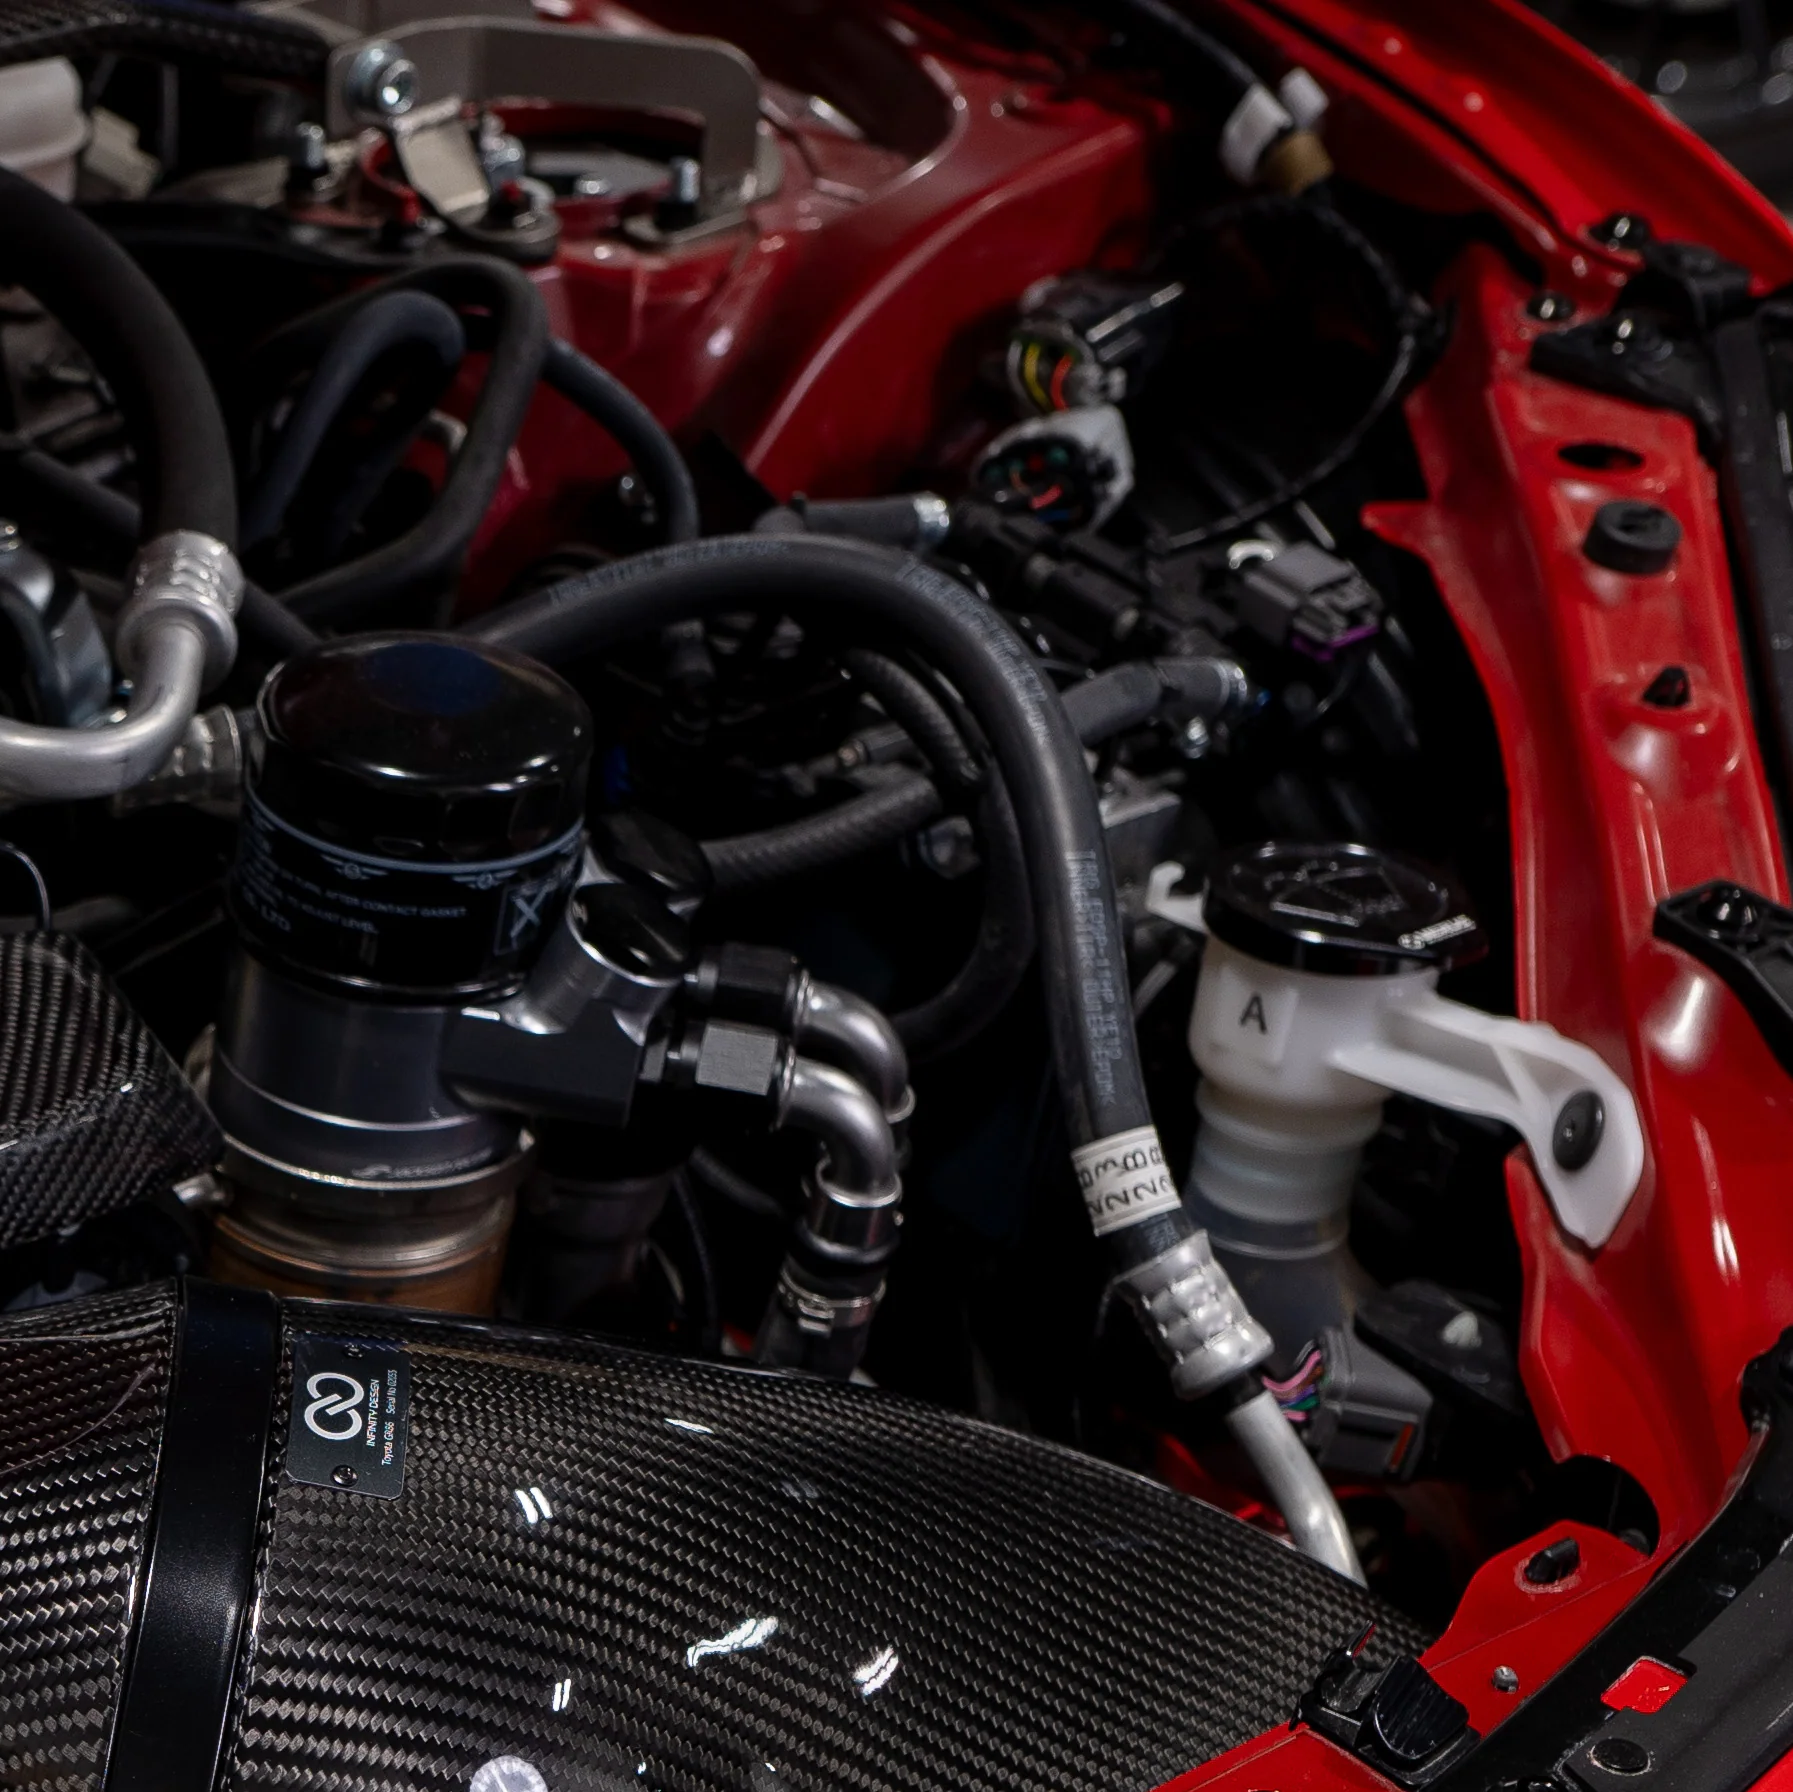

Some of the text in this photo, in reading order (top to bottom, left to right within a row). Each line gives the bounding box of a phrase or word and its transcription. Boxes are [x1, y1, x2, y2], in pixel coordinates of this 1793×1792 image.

[1239, 994, 1267, 1034] A
[366, 1379, 380, 1447] INFINITY DESIGN
[381, 1442, 394, 1466] Toyota
